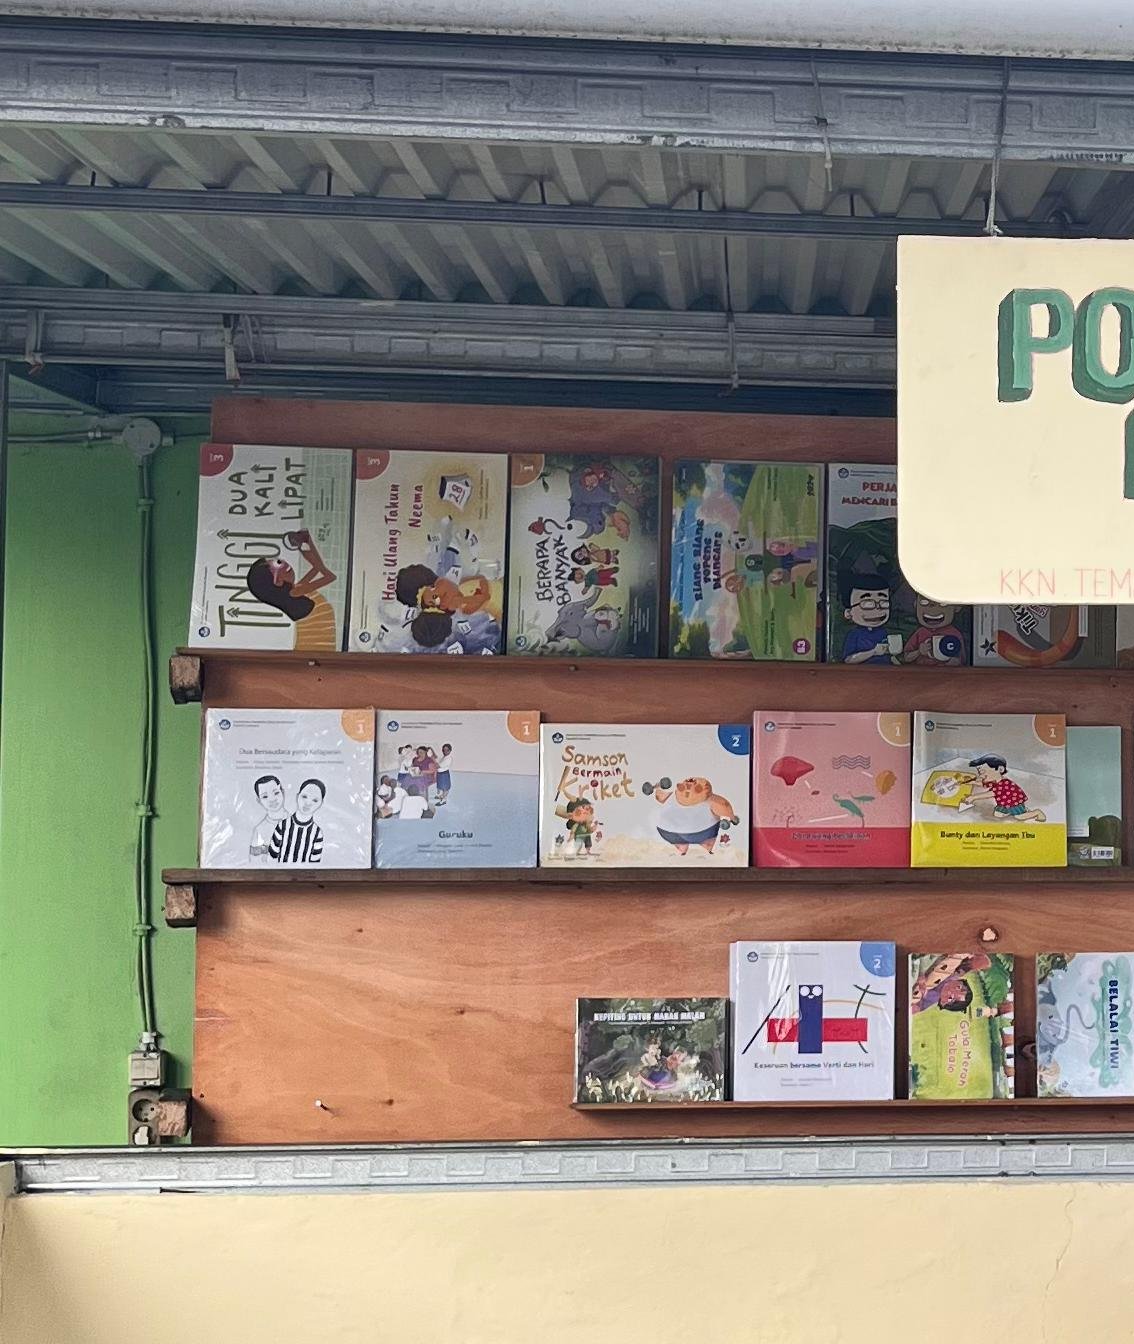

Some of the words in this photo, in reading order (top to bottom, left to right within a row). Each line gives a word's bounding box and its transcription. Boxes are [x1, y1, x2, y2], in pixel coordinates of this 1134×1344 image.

[227, 471, 248, 516] DUA
[250, 463, 277, 518] KALI
[278, 457, 307, 520] LIPAT
[384, 483, 400, 524] Tahun
[408, 484, 423, 528] Neema
[382, 528, 401, 568] Ulang
[381, 571, 396, 601] Hari
[534, 536, 554, 603] BERAPA
[561, 744, 629, 767] Samson
[572, 767, 622, 778] Bermain
[555, 766, 636, 801] Kriket
[438, 830, 474, 840] Guruku
[965, 830, 980, 839] dan
[1109, 979, 1119, 1033] BELALAI
[1109, 1038, 1120, 1069] TIWI
